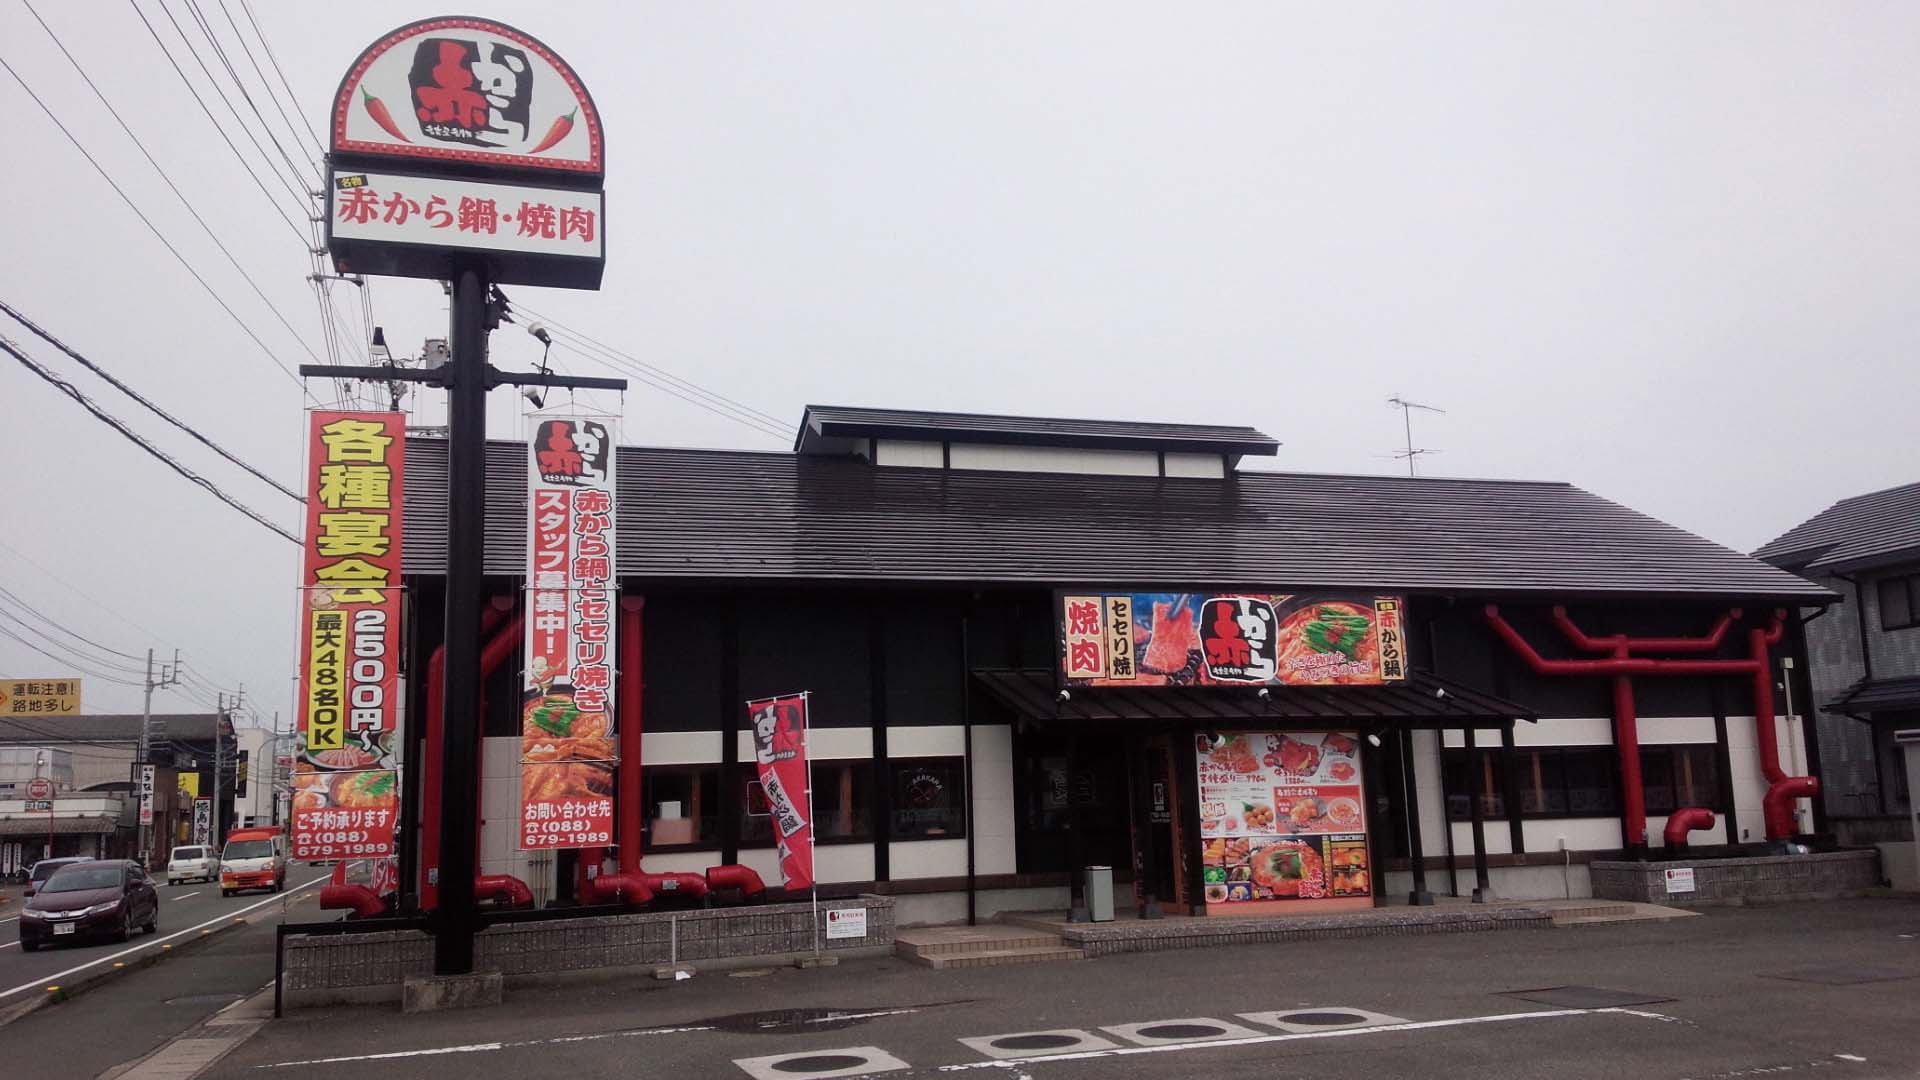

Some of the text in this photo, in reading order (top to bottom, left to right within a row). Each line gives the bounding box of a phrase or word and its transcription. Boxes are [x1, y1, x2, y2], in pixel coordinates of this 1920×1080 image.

[337, 187, 597, 243] 赤から鍋・焼肉
[316, 418, 392, 604] 各種宴会
[571, 488, 612, 713] 赤から鍋とセセリ焼き
[1068, 602, 1101, 672] 焼肉
[1111, 600, 1132, 676] セセリ焼
[1380, 612, 1401, 677] 赤から鍋
[12, 698, 73, 712] 路地多し
[13, 682, 74, 696] 運転注意!
[314, 614, 342, 745] 最大48名OK
[297, 809, 390, 831] ご予約承ります
[525, 800, 611, 820] お問い合わせ先
[297, 843, 388, 856] 679-1989
[525, 832, 609, 845] 679-1989
